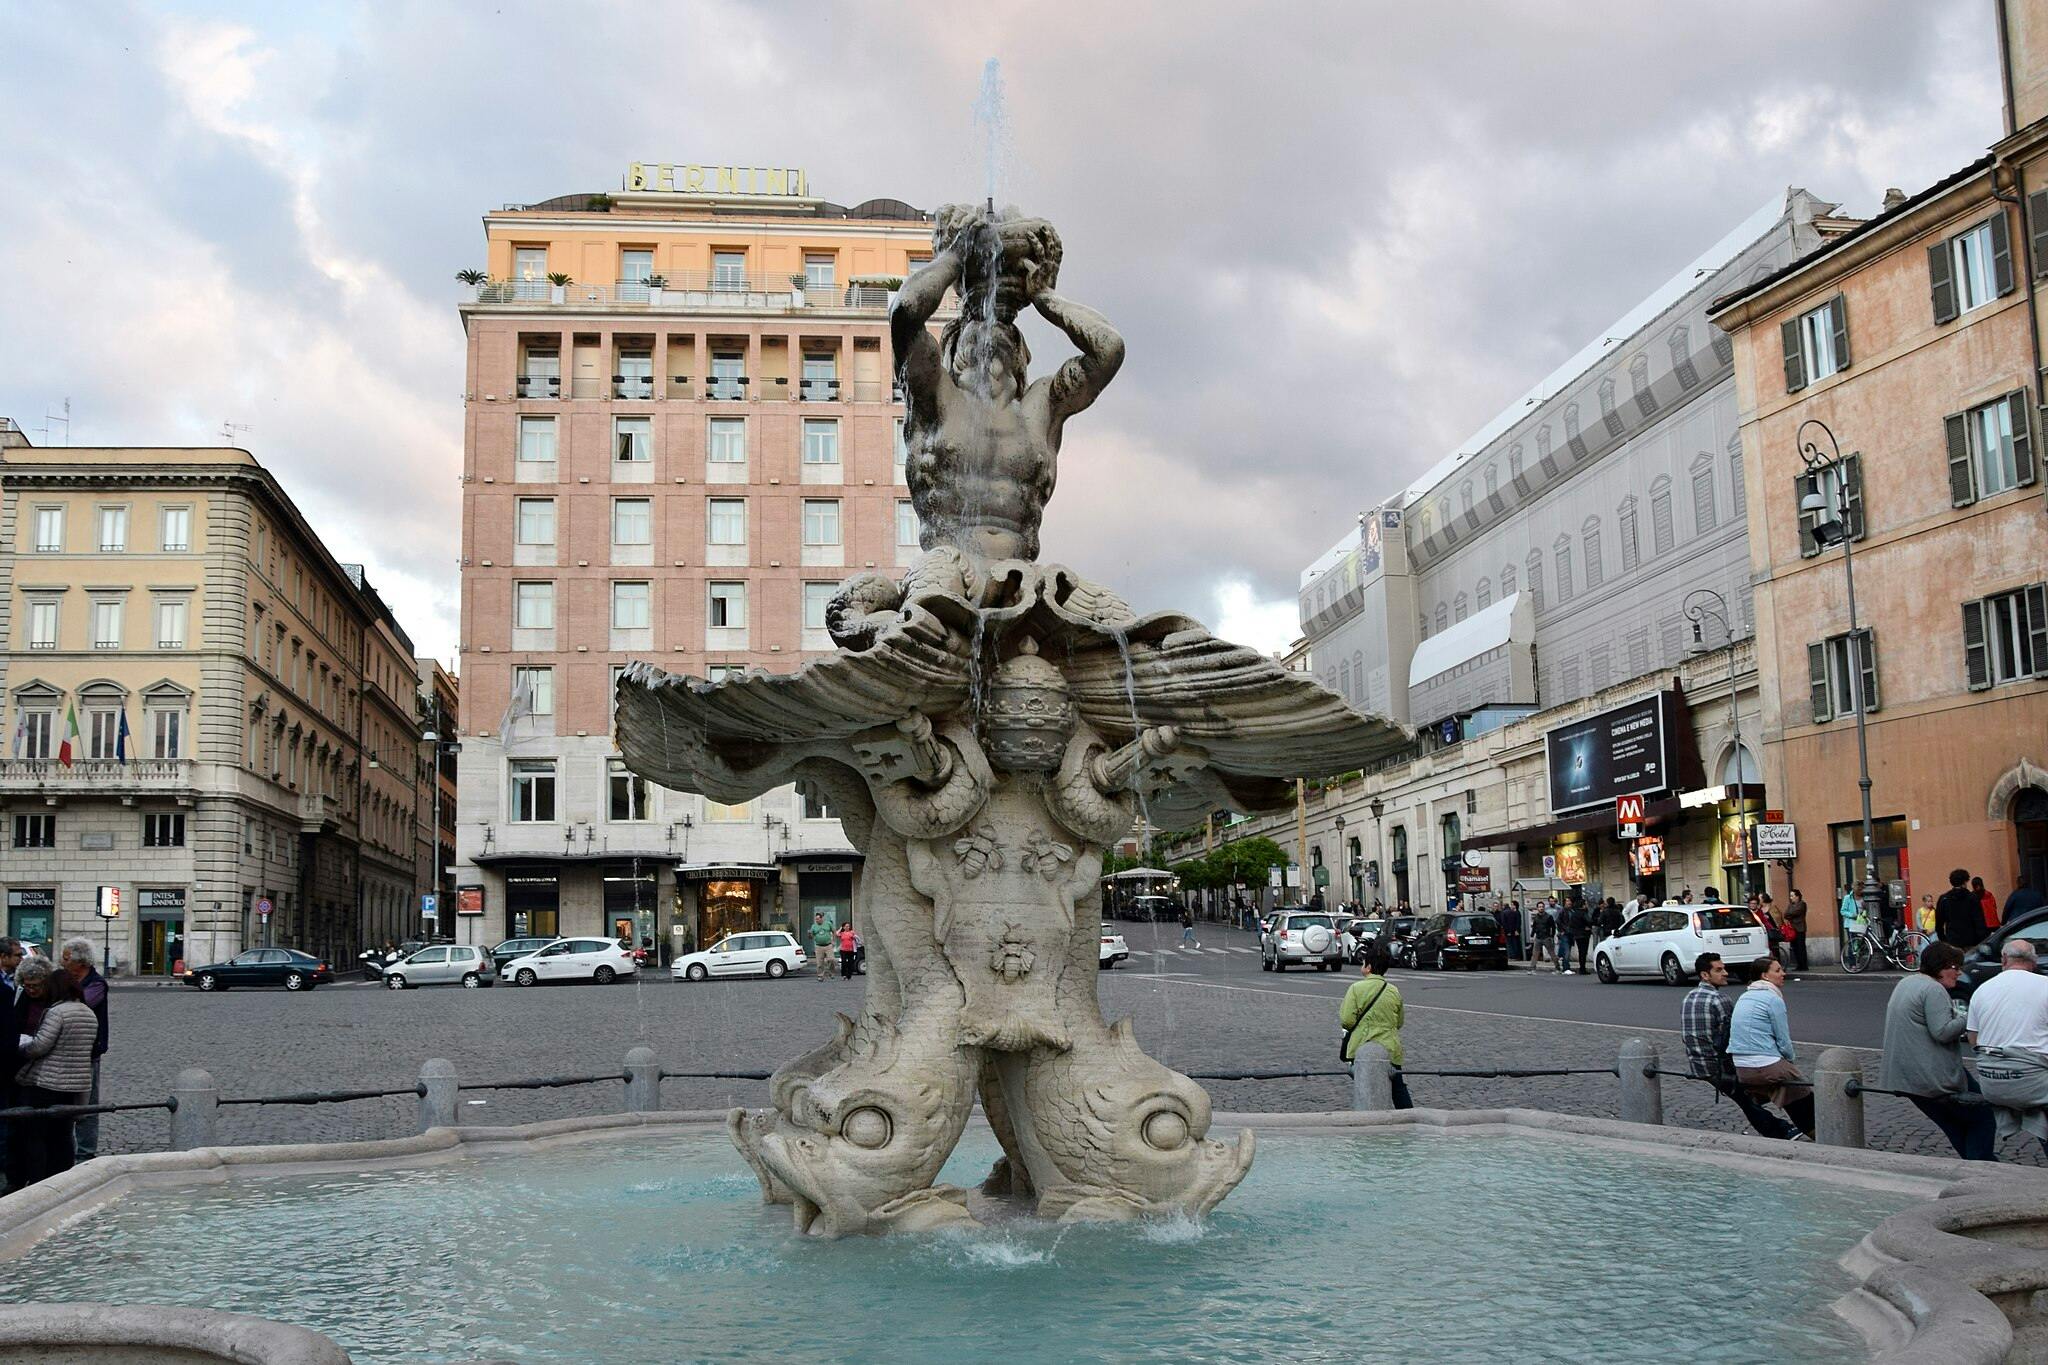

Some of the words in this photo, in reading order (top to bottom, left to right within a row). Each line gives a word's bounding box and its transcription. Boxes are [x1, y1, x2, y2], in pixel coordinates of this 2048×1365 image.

[629, 161, 806, 196] BERNINI
[1619, 800, 1641, 819] M
[1760, 825, 1790, 839] Hotel
[425, 897, 435, 910] P
